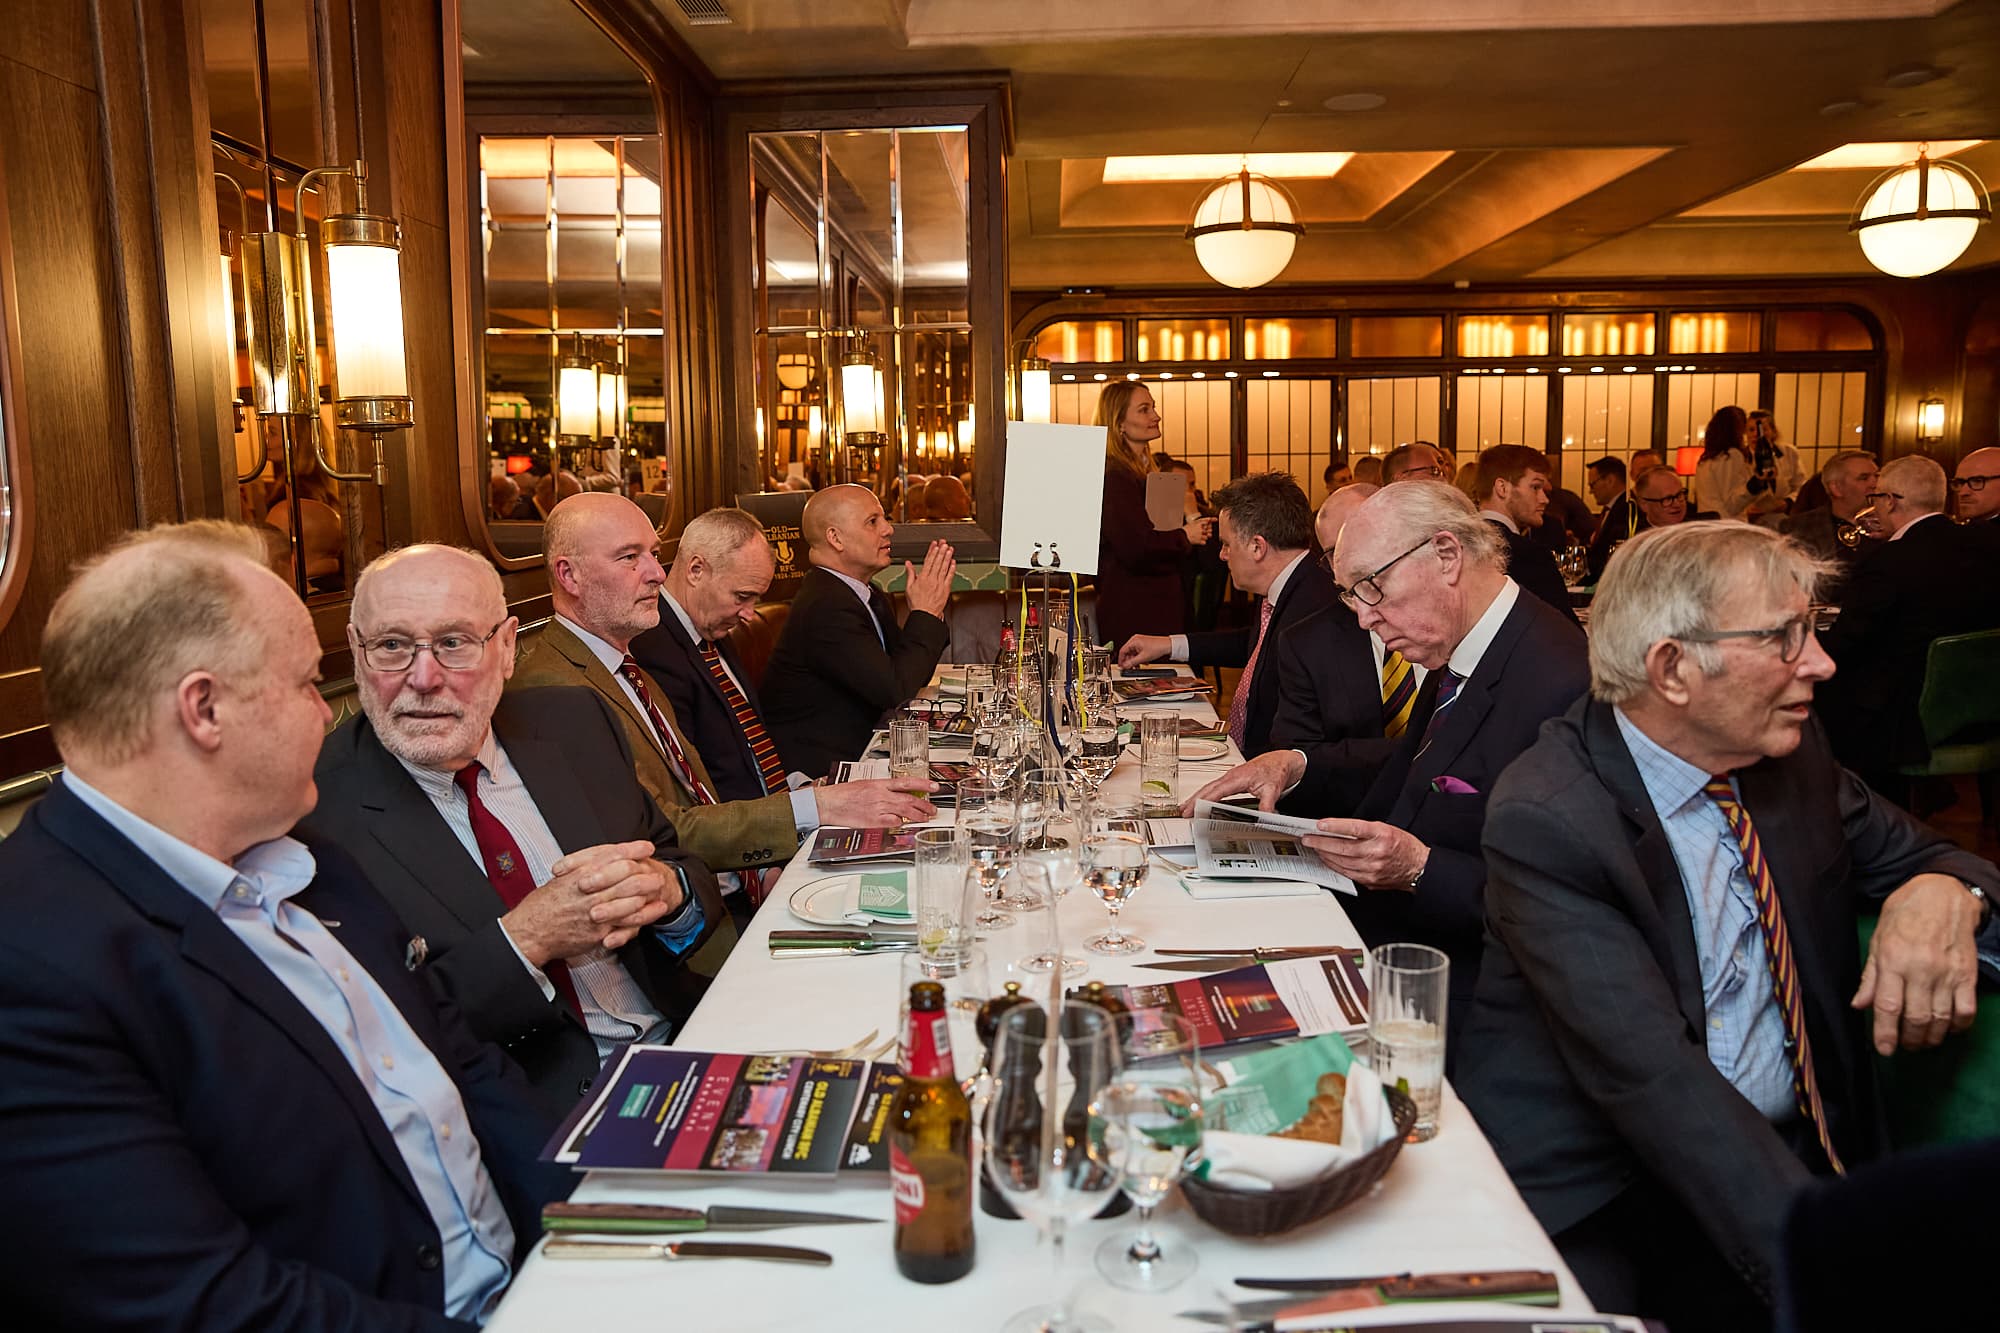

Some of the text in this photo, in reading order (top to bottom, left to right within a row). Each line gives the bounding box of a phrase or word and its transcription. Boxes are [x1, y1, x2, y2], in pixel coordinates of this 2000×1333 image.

[646, 465, 660, 479] 12
[766, 532, 800, 541] LBANIAN
[779, 564, 796, 572] RFC
[814, 1081, 829, 1098] OLD
[696, 1076, 730, 1131] EVENT
